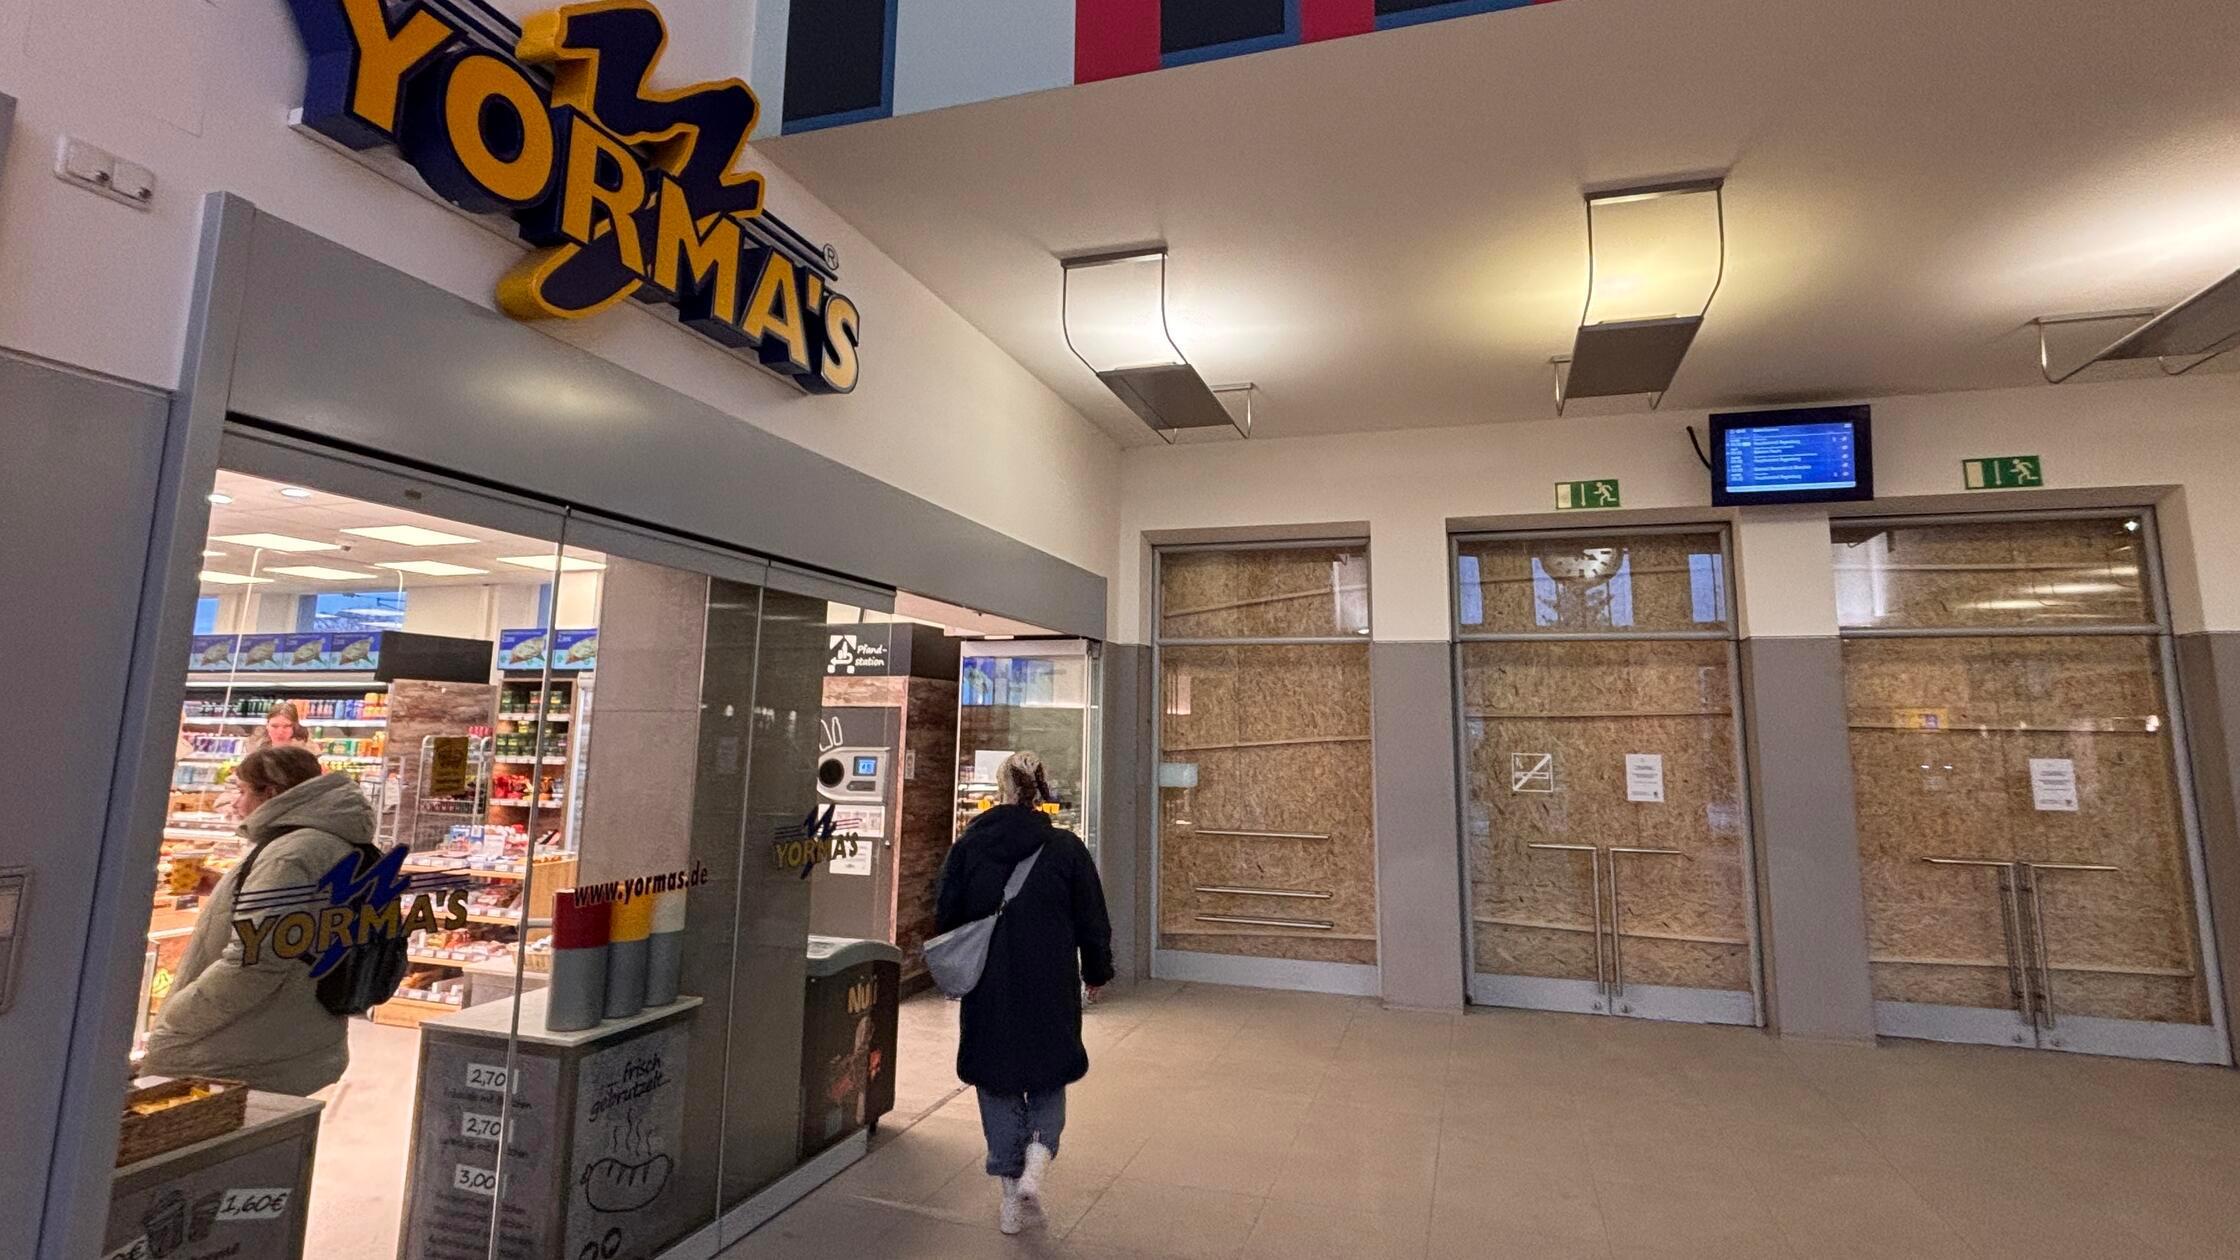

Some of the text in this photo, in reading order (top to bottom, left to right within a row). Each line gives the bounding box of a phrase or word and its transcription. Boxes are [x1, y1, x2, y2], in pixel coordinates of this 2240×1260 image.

[340, 0, 862, 395] YORMA'S
[857, 643, 888, 655] Pfand-
[855, 656, 885, 667] station
[774, 831, 859, 869] YORMA'S
[574, 860, 709, 907] www.yormas.de
[232, 888, 470, 968] YORMA'S
[470, 1069, 507, 1087] 2,70
[466, 1117, 502, 1136] 2,70
[459, 1169, 496, 1190] 3,00
[220, 1192, 288, 1217] 1,60€
